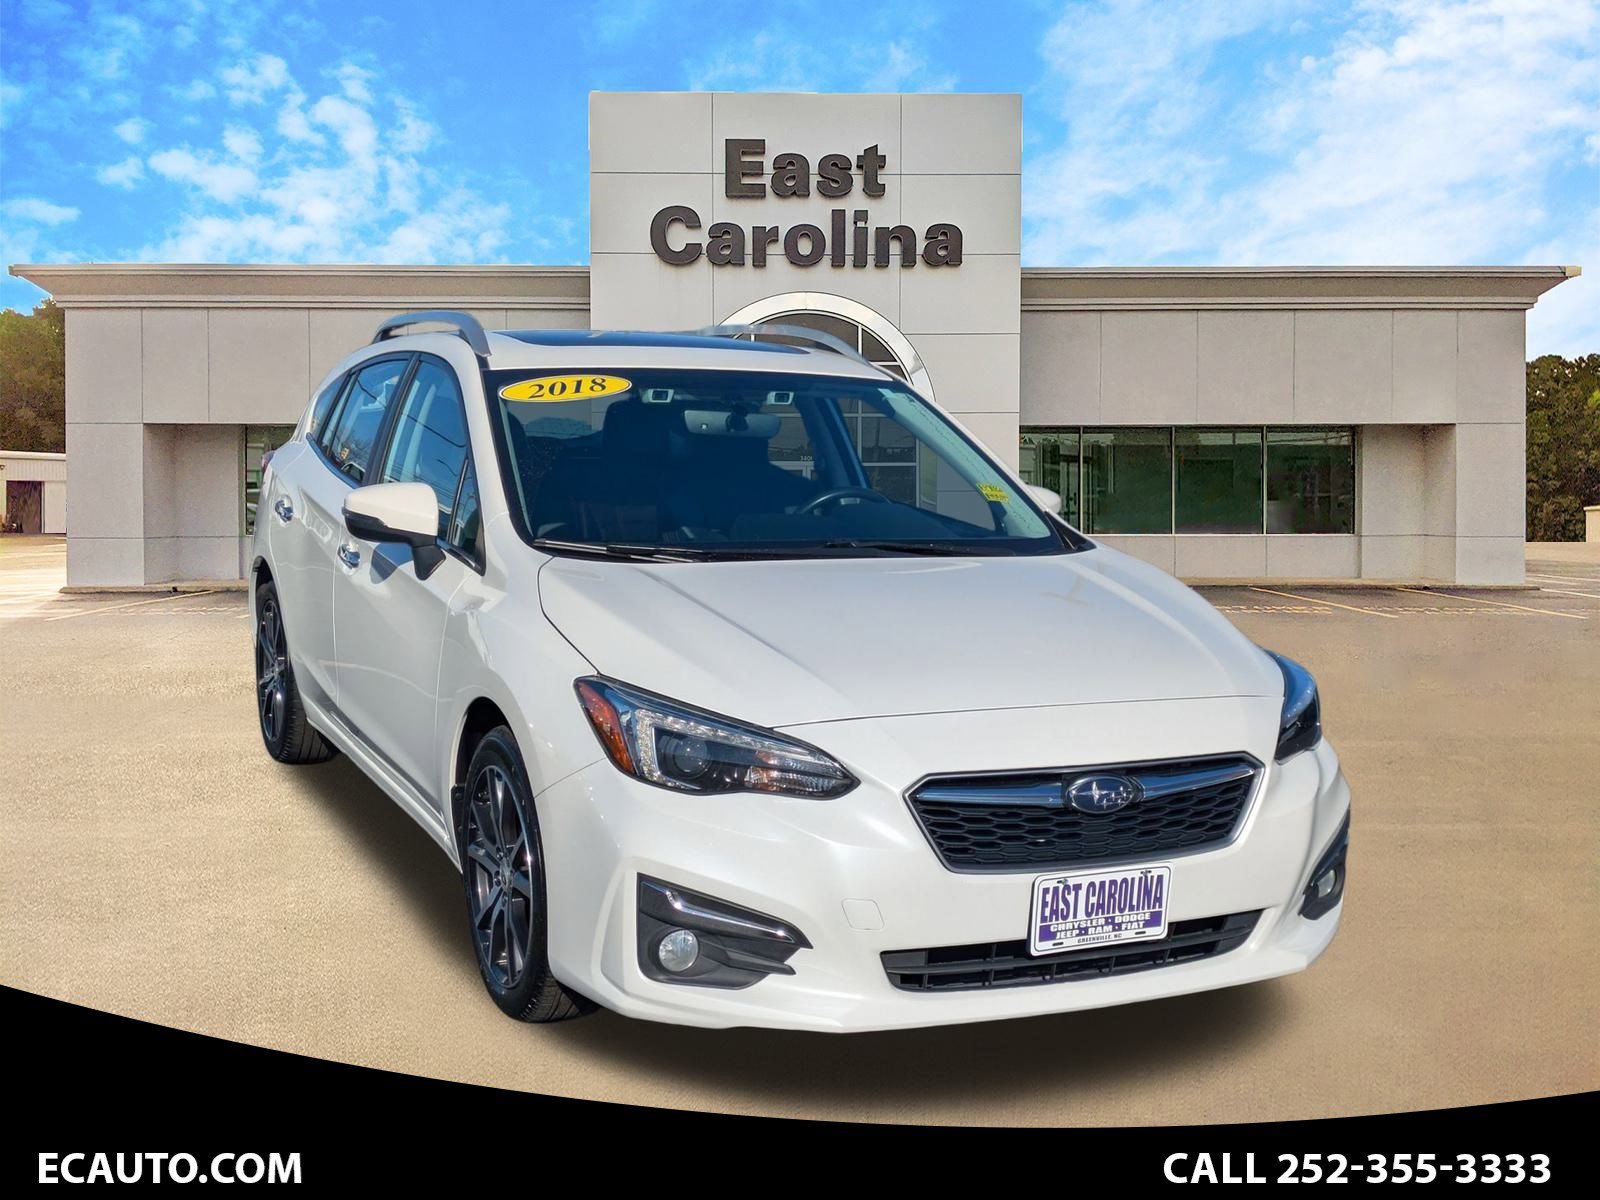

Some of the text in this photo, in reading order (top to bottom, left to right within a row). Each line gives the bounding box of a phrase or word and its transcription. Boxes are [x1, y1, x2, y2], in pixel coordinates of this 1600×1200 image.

[725, 138, 887, 199] East
[650, 205, 963, 268] Carolina
[527, 377, 607, 399] 2018
[1040, 874, 1164, 923] EAST CAROLINA
[1050, 912, 1151, 932] CHRYSLER DODGE
[1056, 920, 1145, 940] JEEP RAM FIAT
